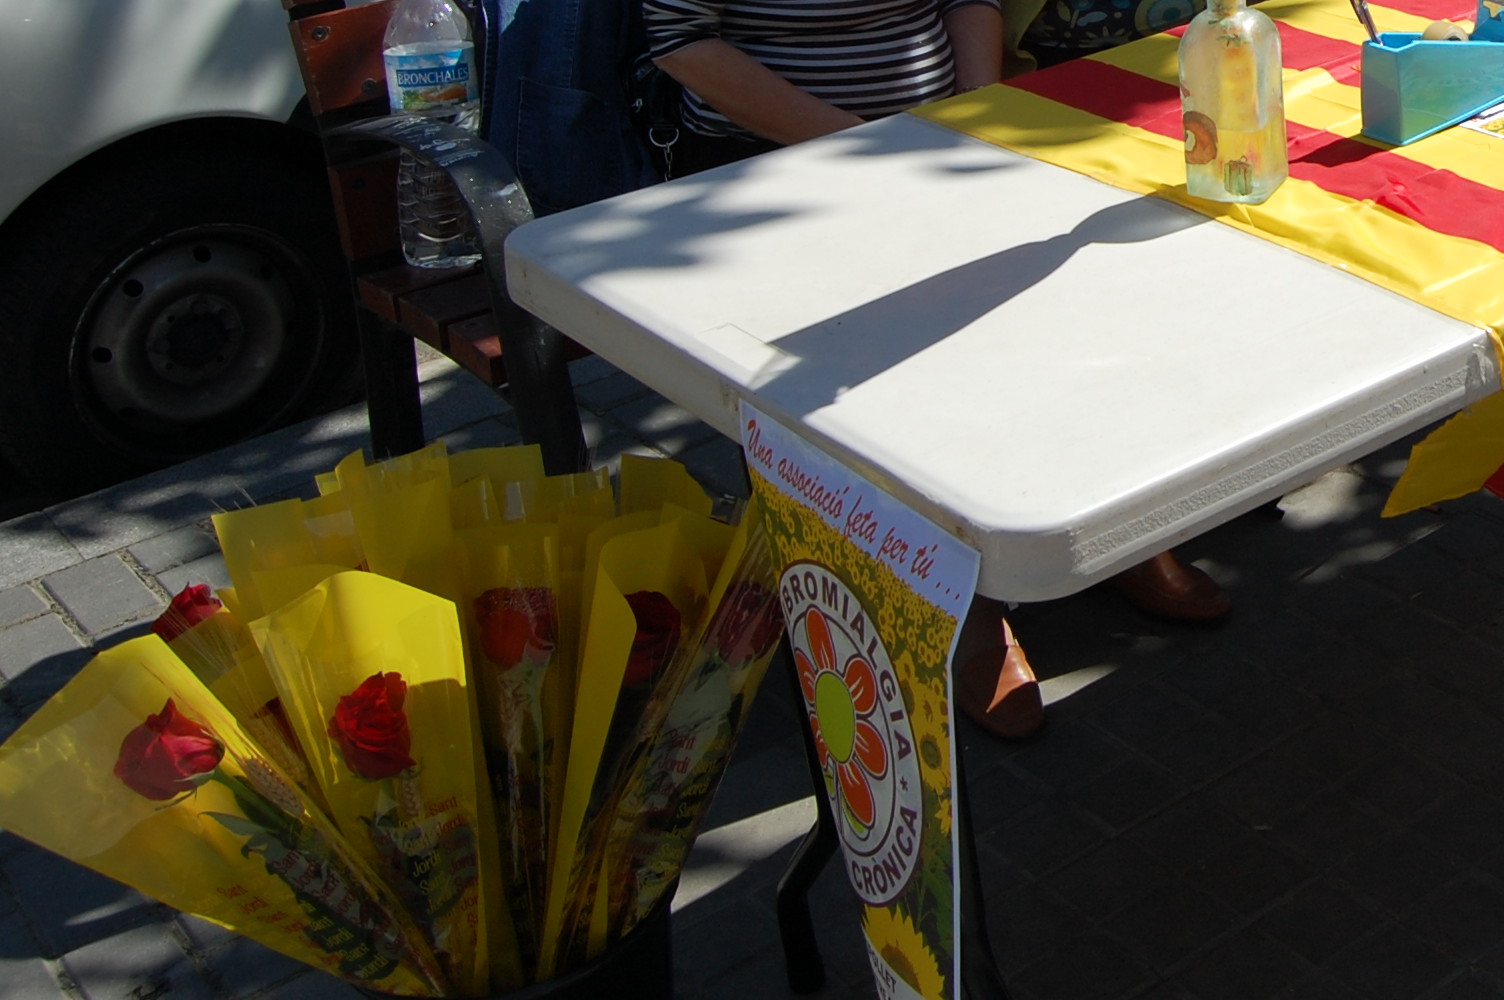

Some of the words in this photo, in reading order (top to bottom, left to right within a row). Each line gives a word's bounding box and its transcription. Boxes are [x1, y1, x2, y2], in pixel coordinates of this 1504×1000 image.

[397, 64, 470, 87] BRONCHALES
[748, 419, 773, 470] Una
[778, 458, 850, 519] associació
[844, 496, 879, 543] feta
[876, 527, 909, 564] per
